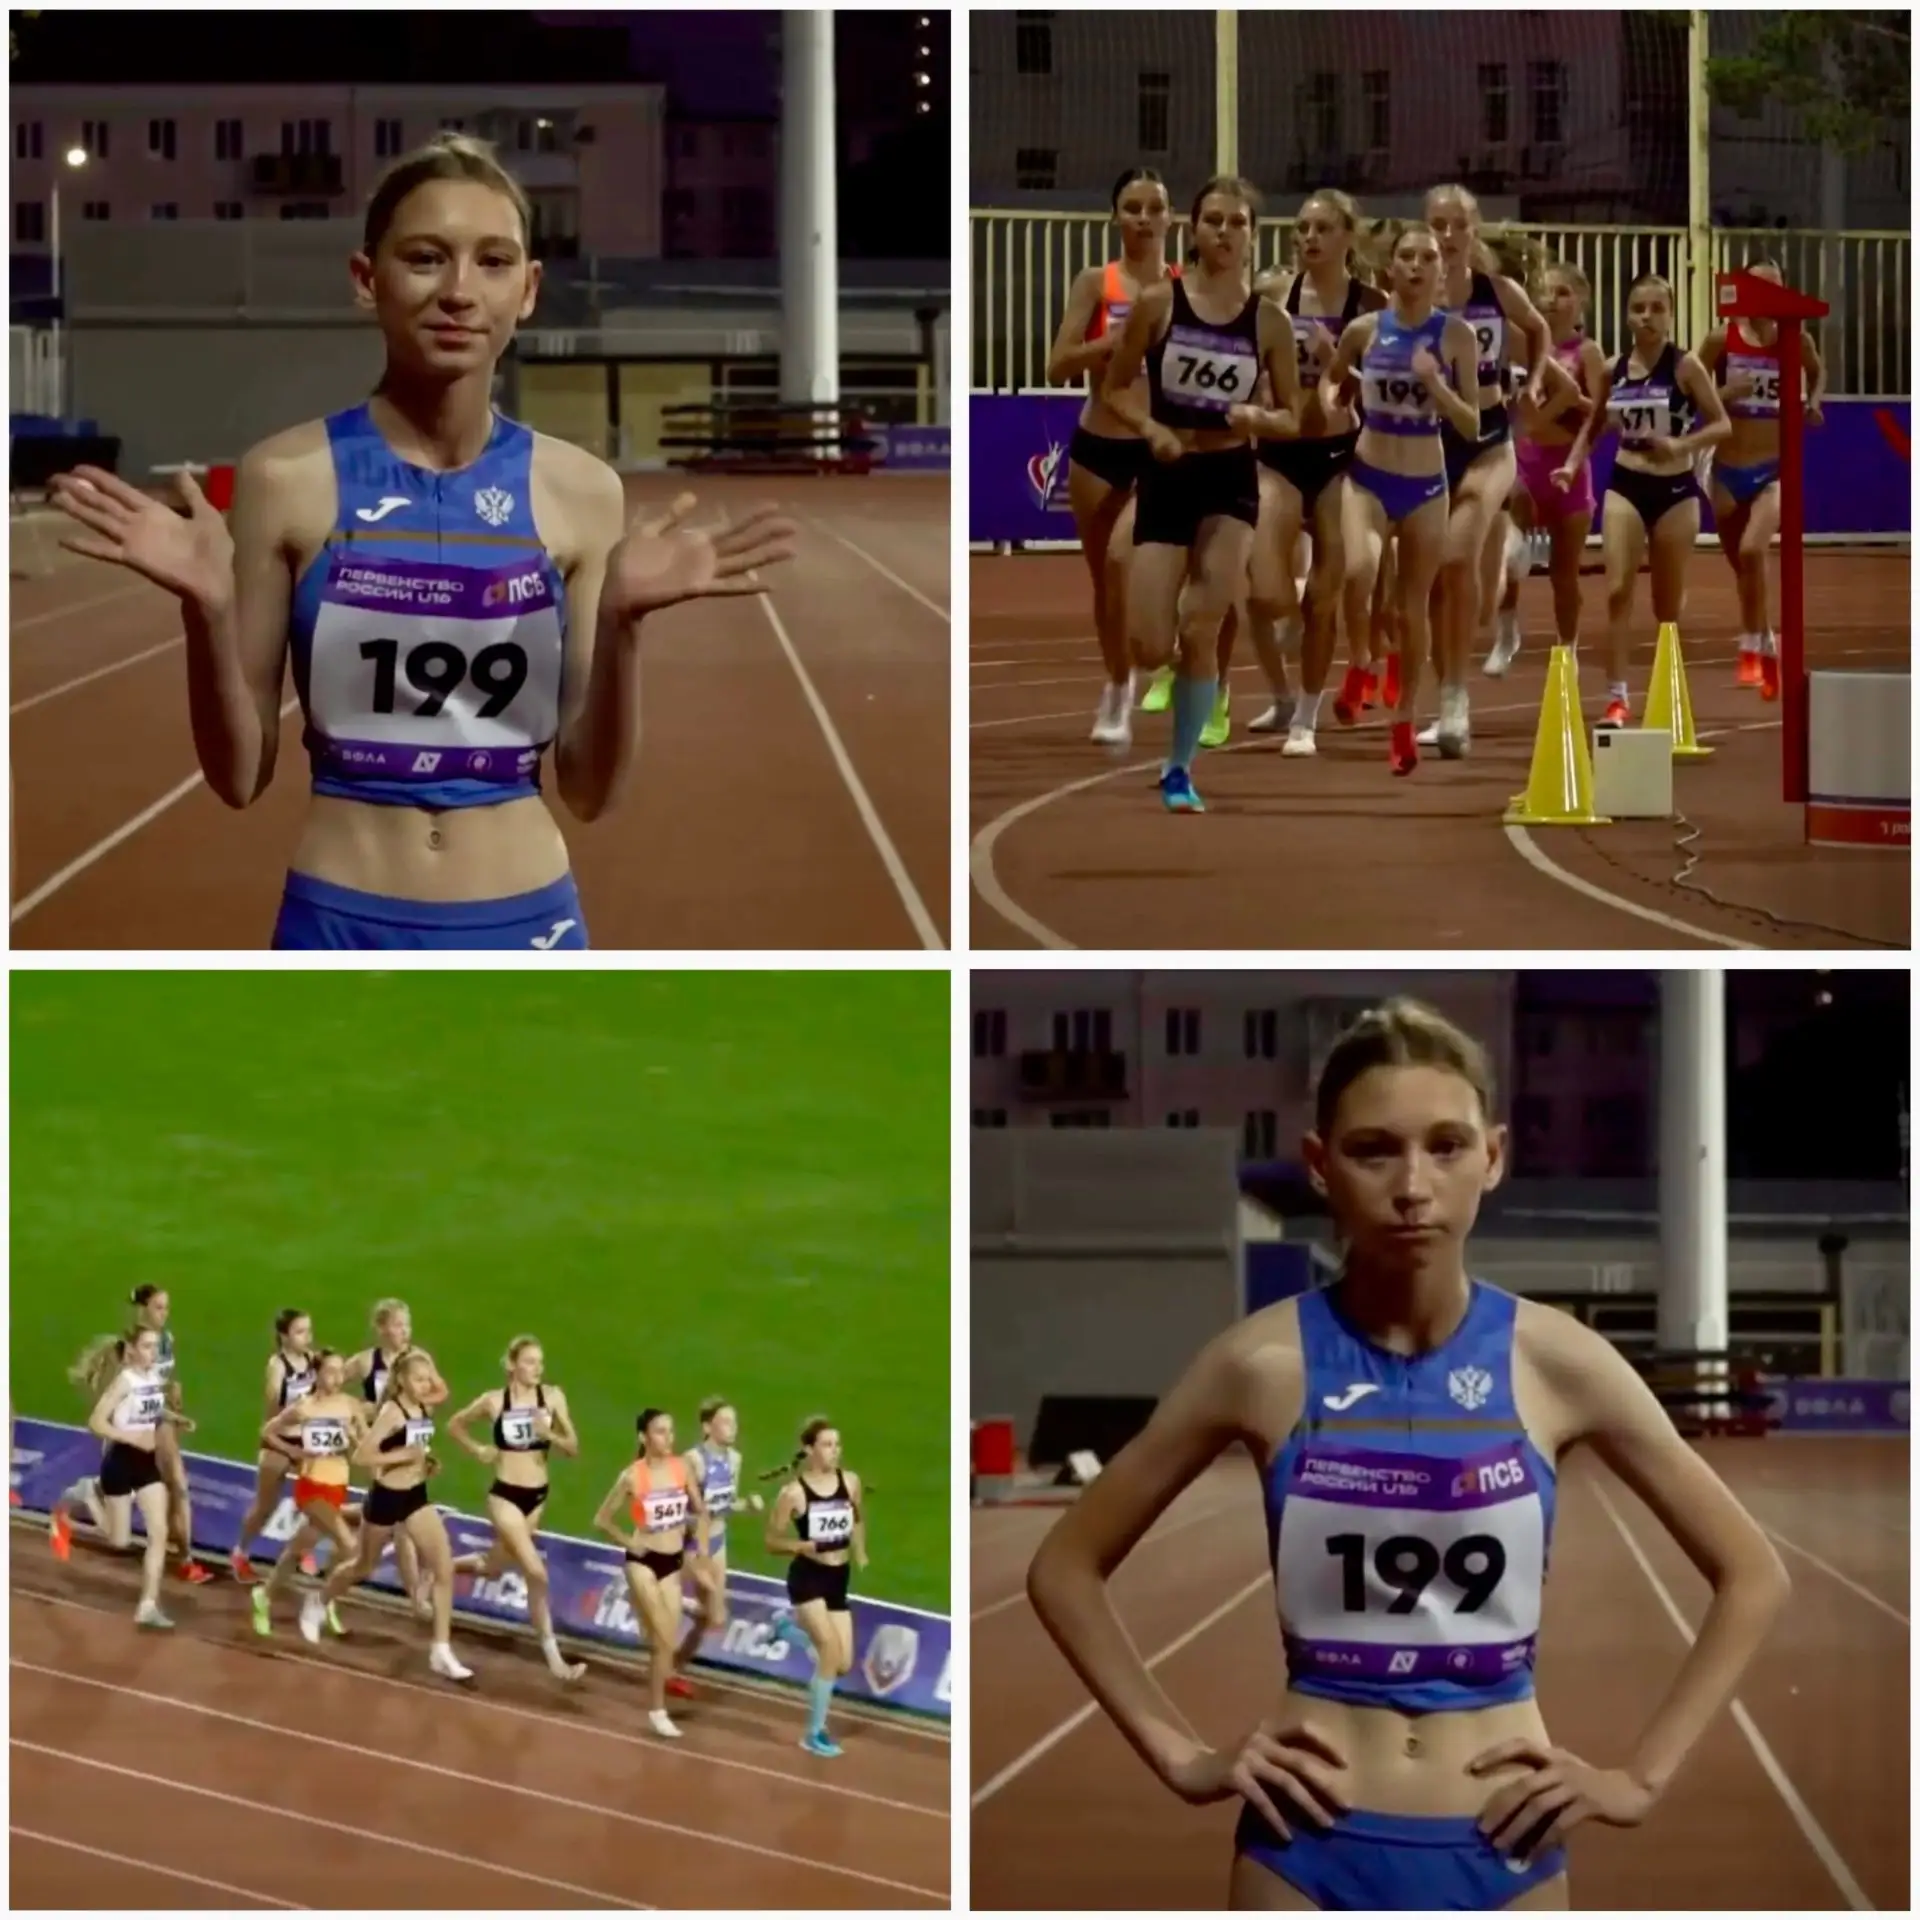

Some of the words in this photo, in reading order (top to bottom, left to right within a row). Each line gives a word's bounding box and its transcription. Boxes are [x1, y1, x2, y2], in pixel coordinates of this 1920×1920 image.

[1176, 355, 1240, 393] 766
[335, 579, 413, 601] РОССИИ
[339, 567, 464, 593] ПЕРВЕНСТВО
[508, 571, 546, 604] ПСБ
[359, 638, 529, 718] 199
[311, 1431, 343, 1447] 526
[1304, 1457, 1432, 1483] ПЕРВЕНСТВО
[1478, 1457, 1525, 1493] ПСБ
[654, 1502, 683, 1521] 541
[818, 1516, 848, 1532] 766
[1325, 1533, 1506, 1614] 199
